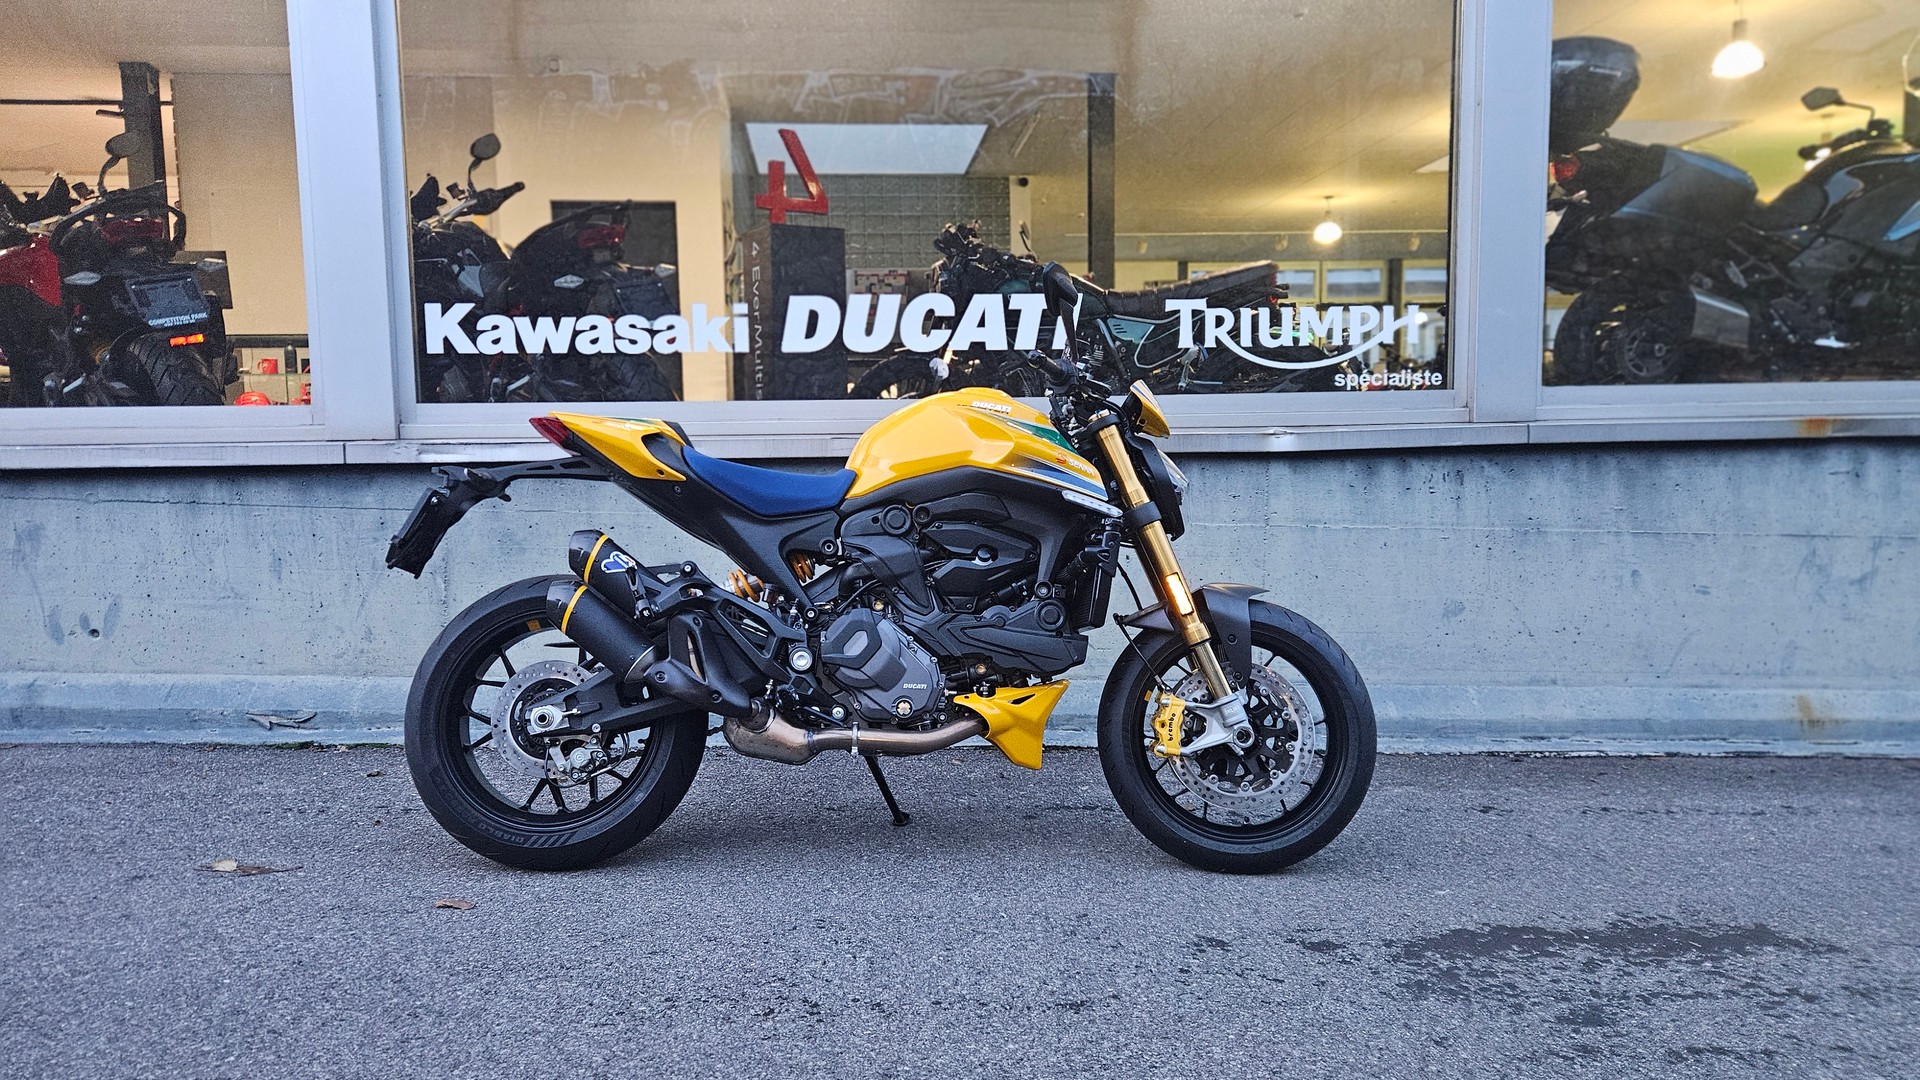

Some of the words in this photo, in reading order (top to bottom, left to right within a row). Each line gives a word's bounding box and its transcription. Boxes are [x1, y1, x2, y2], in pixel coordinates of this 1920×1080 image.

[752, 241, 760, 257] 4
[148, 314, 190, 326] COMPETITION
[424, 302, 750, 355] Kawasaki
[1165, 298, 1420, 369] TRIUMPH
[1334, 369, 1443, 390] spécialiste
[972, 401, 1012, 414] DUCATI
[1167, 712, 1177, 742] brembo
